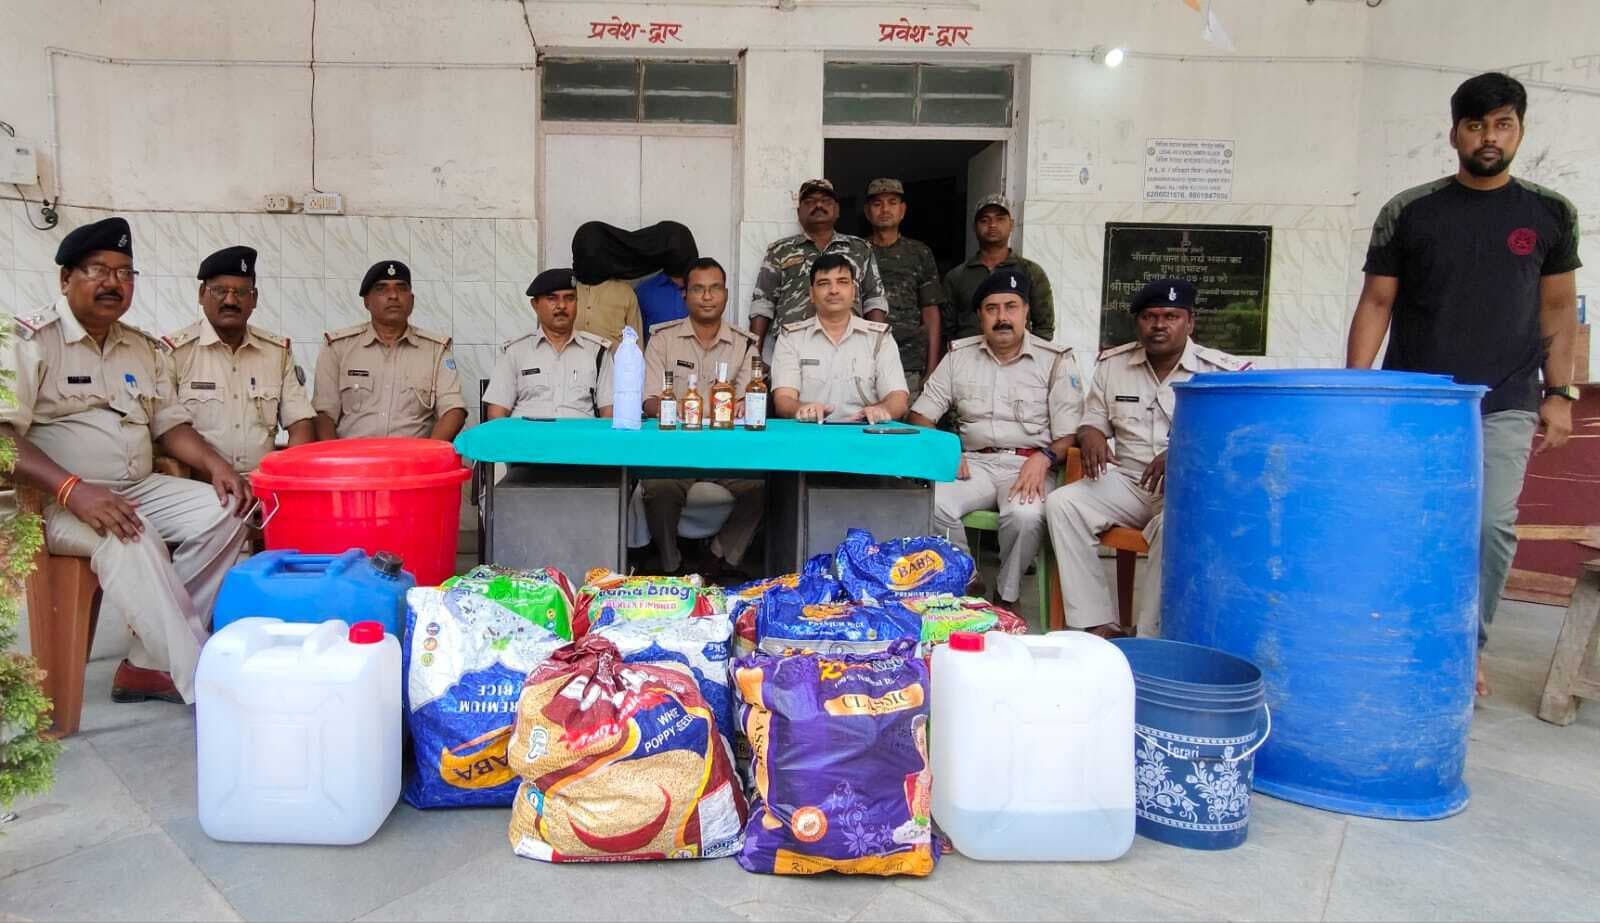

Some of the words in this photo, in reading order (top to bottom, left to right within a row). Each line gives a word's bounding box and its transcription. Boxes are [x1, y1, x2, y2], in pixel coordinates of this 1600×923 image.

[898, 555, 935, 578] BABA
[477, 685, 513, 696] RICE
[459, 700, 519, 713] REMIUM
[645, 726, 676, 753] POPPY
[454, 747, 509, 781] ABA
